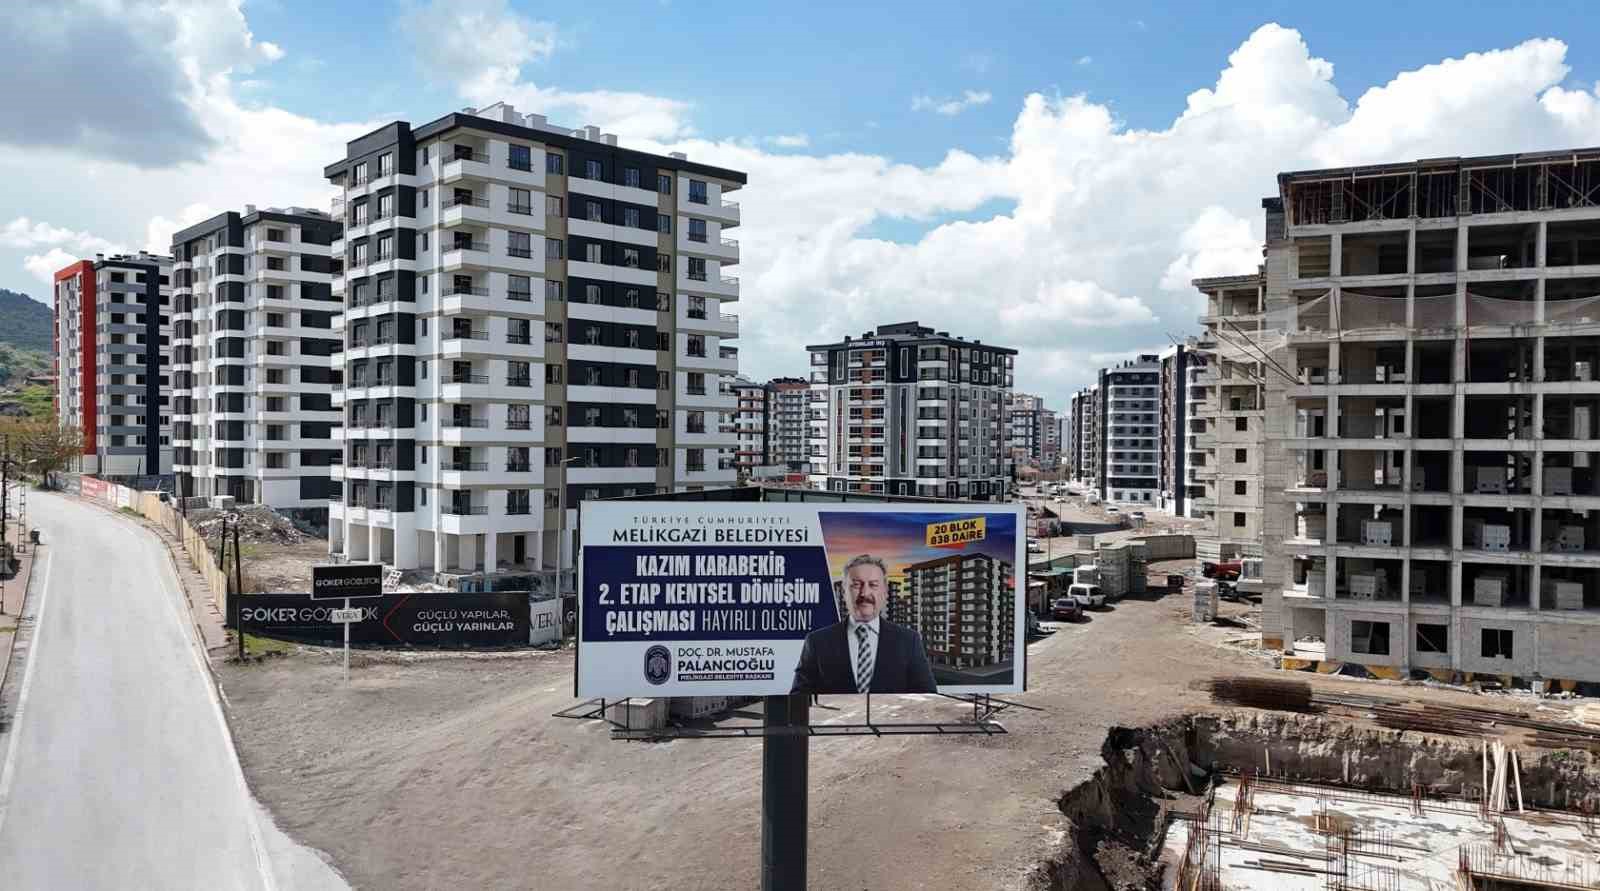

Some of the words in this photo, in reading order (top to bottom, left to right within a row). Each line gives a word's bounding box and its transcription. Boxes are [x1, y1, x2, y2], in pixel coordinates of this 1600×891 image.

[612, 526, 706, 542] MELİKGAZİ
[715, 526, 808, 542] BELEDİYESİ
[934, 524, 947, 534] 20
[950, 520, 976, 532] BLOK
[636, 555, 690, 576] KAZIM
[695, 550, 785, 576] KARABEKİR
[599, 584, 614, 605] 2.
[620, 583, 661, 604] ETAP
[665, 583, 736, 604] KENTSEL
[741, 578, 820, 607] DÖNÜŞÜM
[417, 608, 457, 622] GÜÇLÜ
[606, 610, 695, 635] ÇALIŞMASI
[702, 610, 756, 631] HAYIRLI
[761, 609, 813, 630] OLSUN!
[413, 621, 453, 634] GÜÇLÜ
[456, 622, 514, 631] YARINLAR
[678, 648, 703, 659] DOÇ.
[706, 647, 722, 656] DR.
[726, 647, 775, 656] MUSTAFA
[678, 658, 775, 671] PALANCIOĞLU
